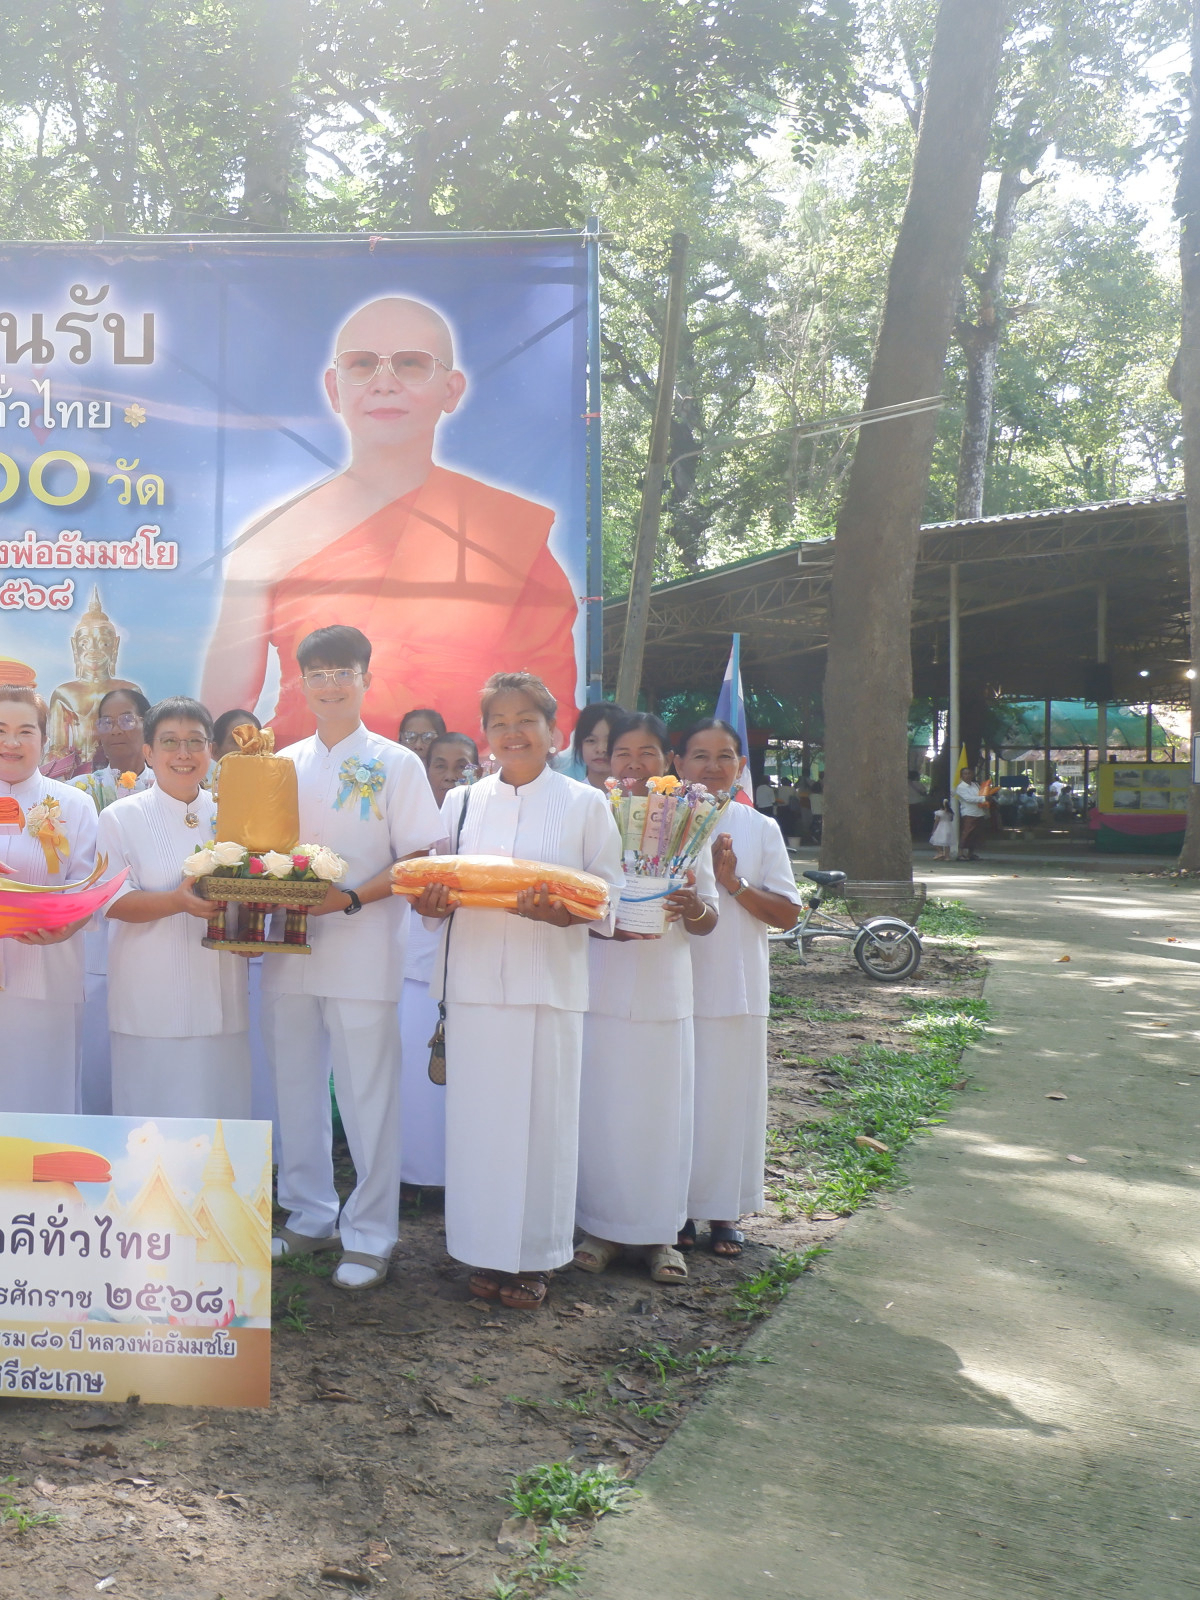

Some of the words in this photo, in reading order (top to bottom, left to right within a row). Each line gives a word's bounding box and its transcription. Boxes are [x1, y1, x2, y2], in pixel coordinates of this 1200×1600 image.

[106, 457, 165, 506] วัด
[104, 1281, 224, 1314] ๒๕๖๘
[30, 1329, 64, 1349] ๘๑
[68, 1328, 83, 1350] ปี
[87, 1330, 237, 1357] หลวงพ่อธัมมชโย
